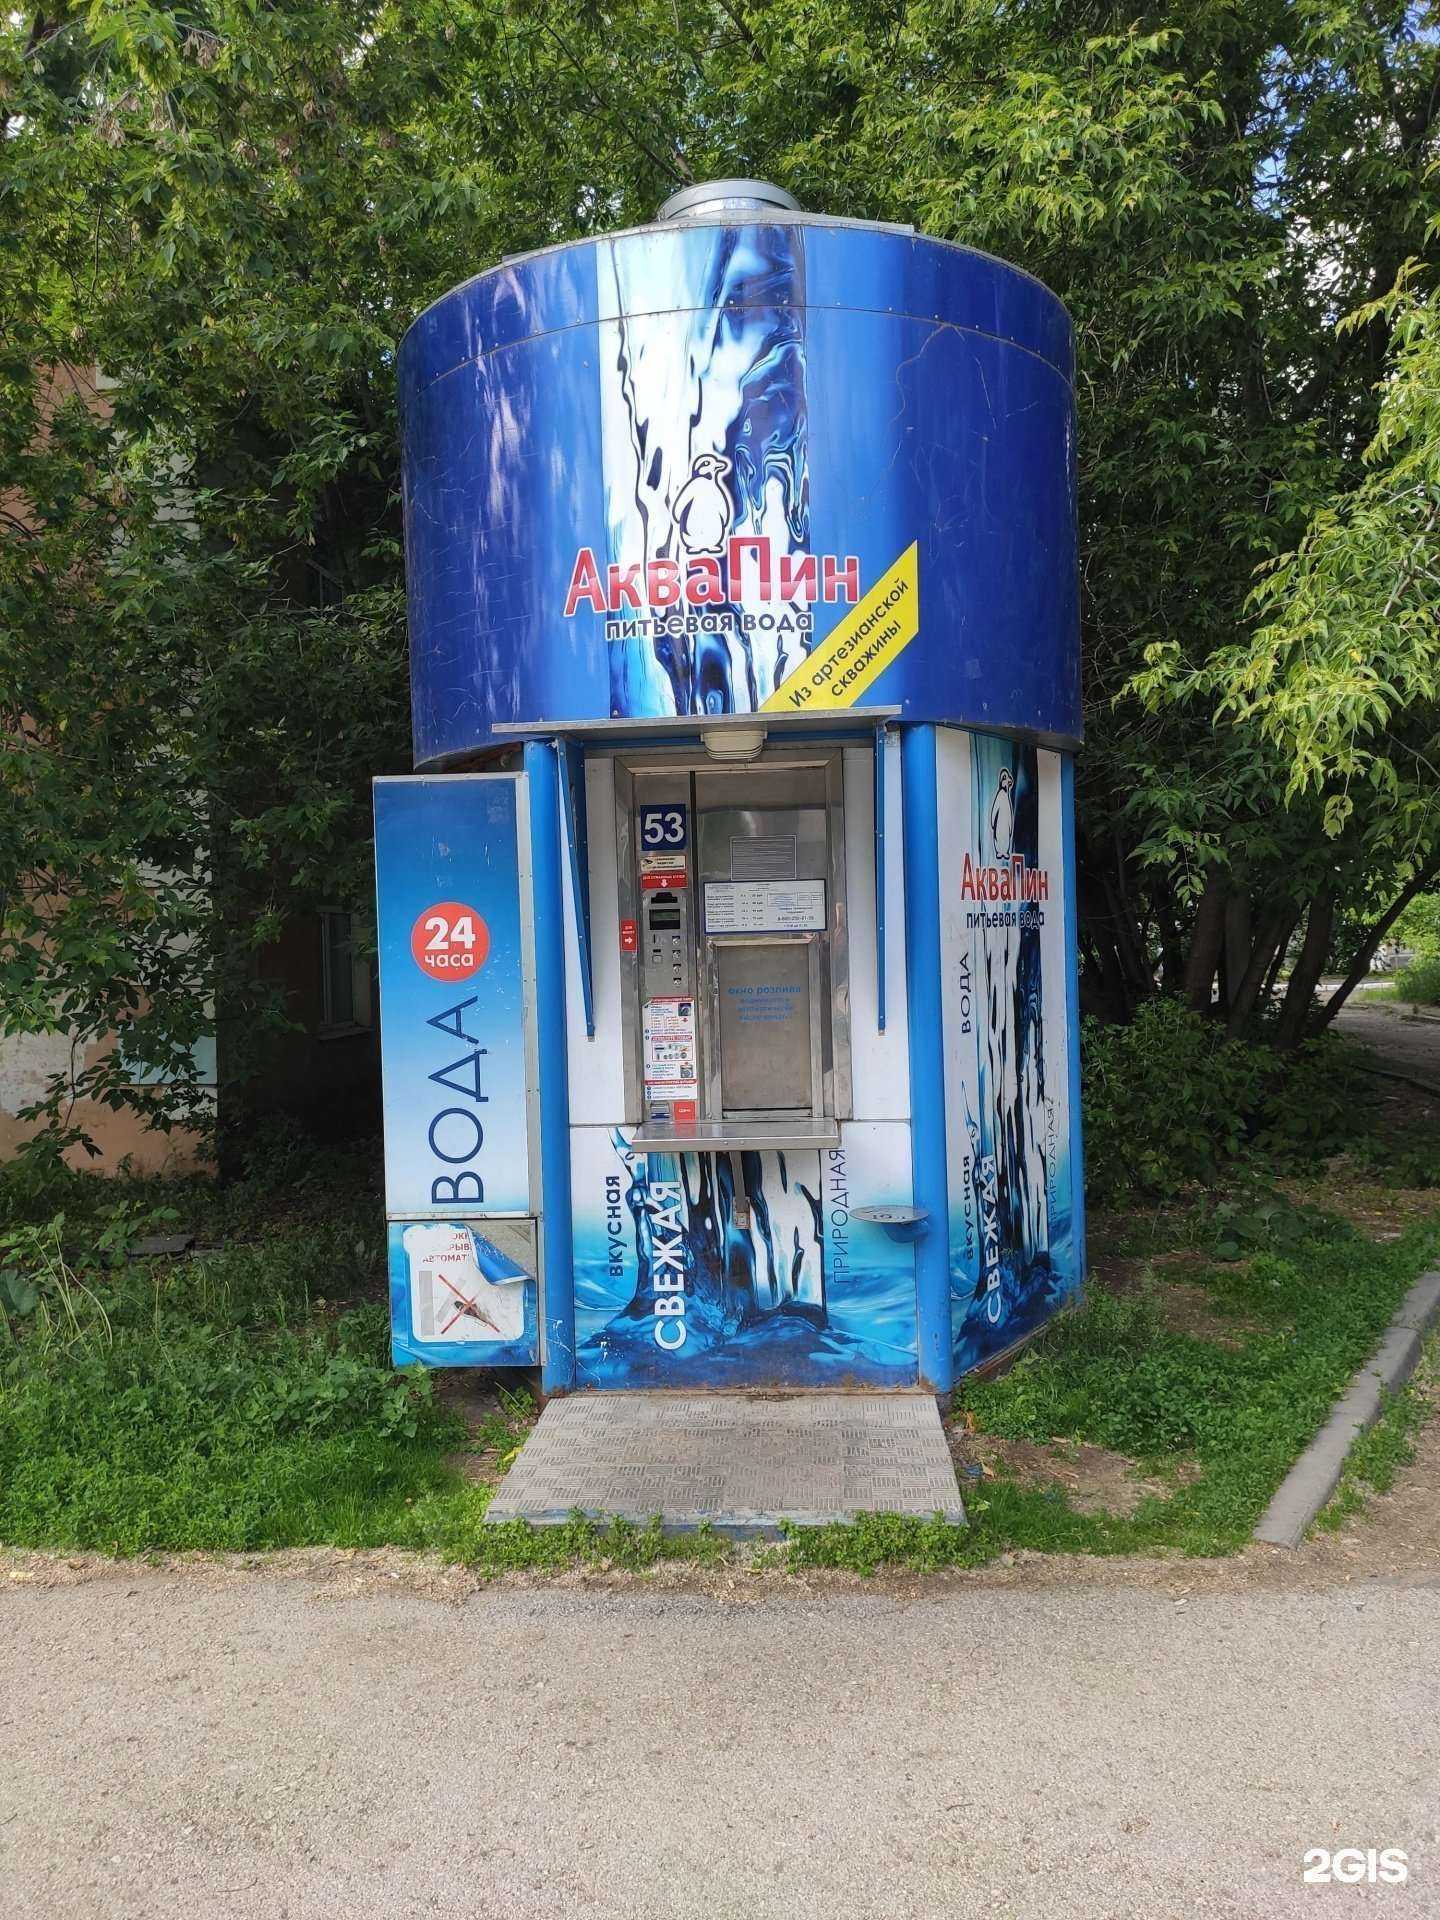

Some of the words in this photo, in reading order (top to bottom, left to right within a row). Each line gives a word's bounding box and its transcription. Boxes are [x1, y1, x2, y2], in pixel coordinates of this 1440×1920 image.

[564, 535, 860, 616] АкваПин
[605, 613, 734, 640] питьевая
[743, 611, 813, 634] вода
[788, 685, 812, 708] Из
[811, 576, 910, 685] артезианской
[831, 619, 902, 698] скважины
[644, 812, 685, 844] 53
[960, 852, 1049, 901] АкваПин
[424, 916, 476, 951] 24
[966, 911, 1017, 930] питьевая
[1019, 910, 1045, 929] вода
[424, 952, 474, 969] часа
[960, 951, 972, 1035] ВОДА
[426, 995, 489, 1204] ВОДА
[828, 1149, 850, 1284] ПРИРОДНАЯ
[981, 1153, 1002, 1325] СВЕЖАЯ
[650, 1181, 690, 1351] СВЕЖАЯ
